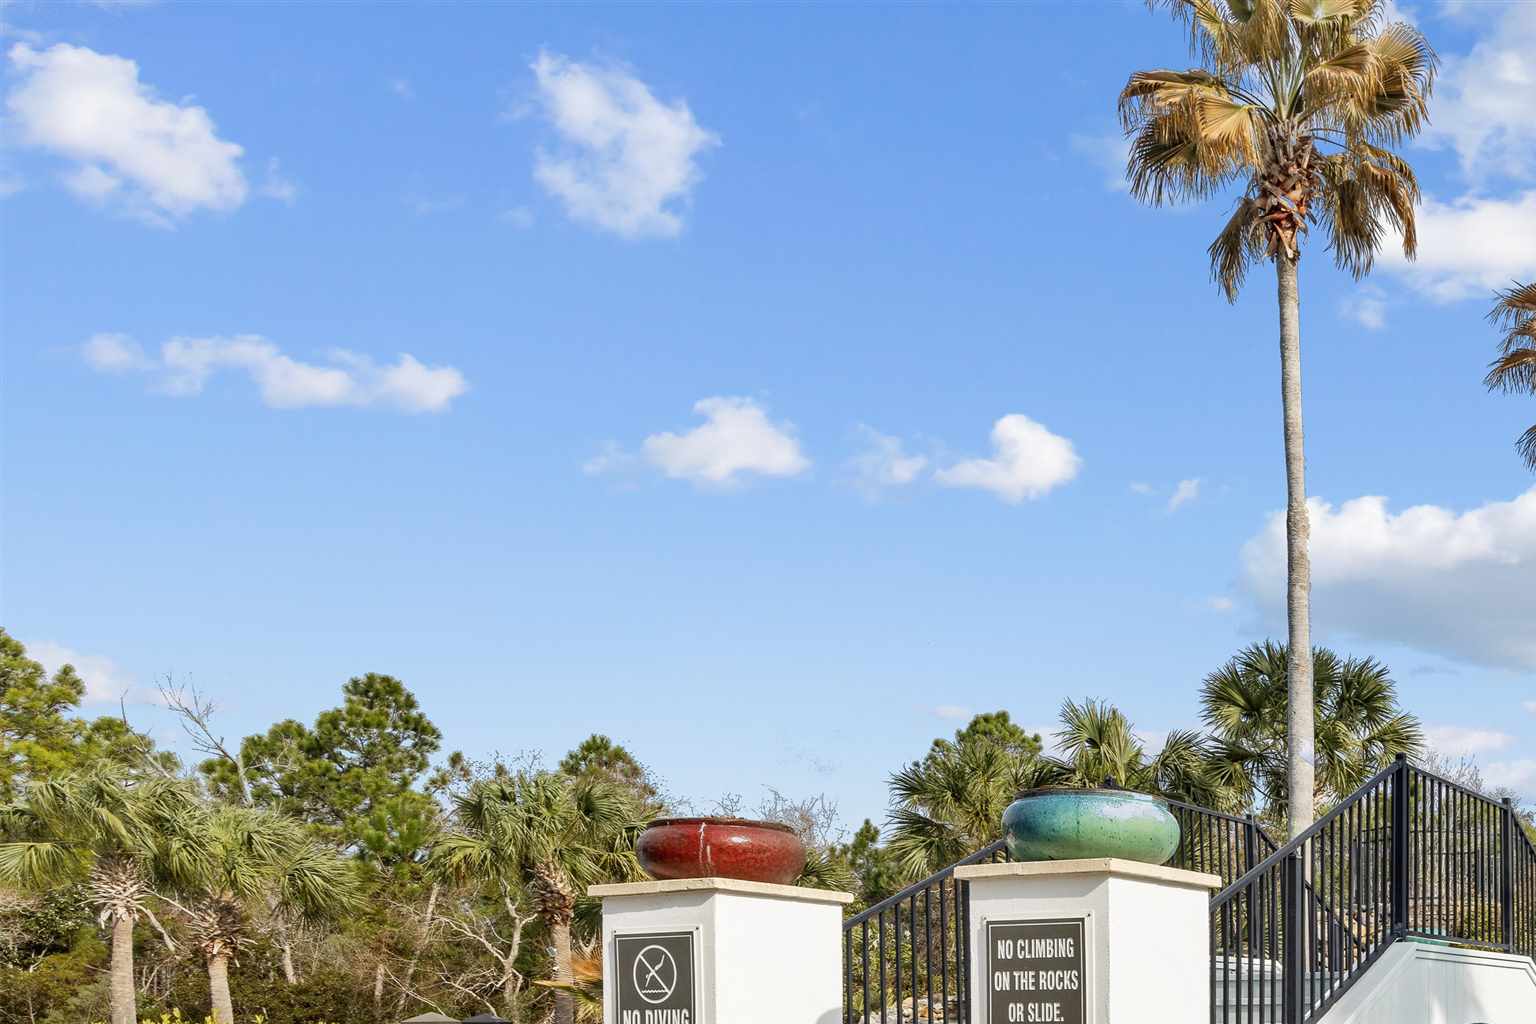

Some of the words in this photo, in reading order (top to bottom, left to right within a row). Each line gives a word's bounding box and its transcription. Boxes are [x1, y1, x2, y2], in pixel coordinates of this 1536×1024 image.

[997, 939, 1013, 960] NO
[1017, 937, 1075, 959] CLIMBING
[994, 971, 1010, 991] ON
[1013, 970, 1036, 991] THE
[1039, 969, 1079, 990] ROCKS
[1008, 1002, 1024, 1022] OR
[1027, 1002, 1065, 1022] SLIDE.
